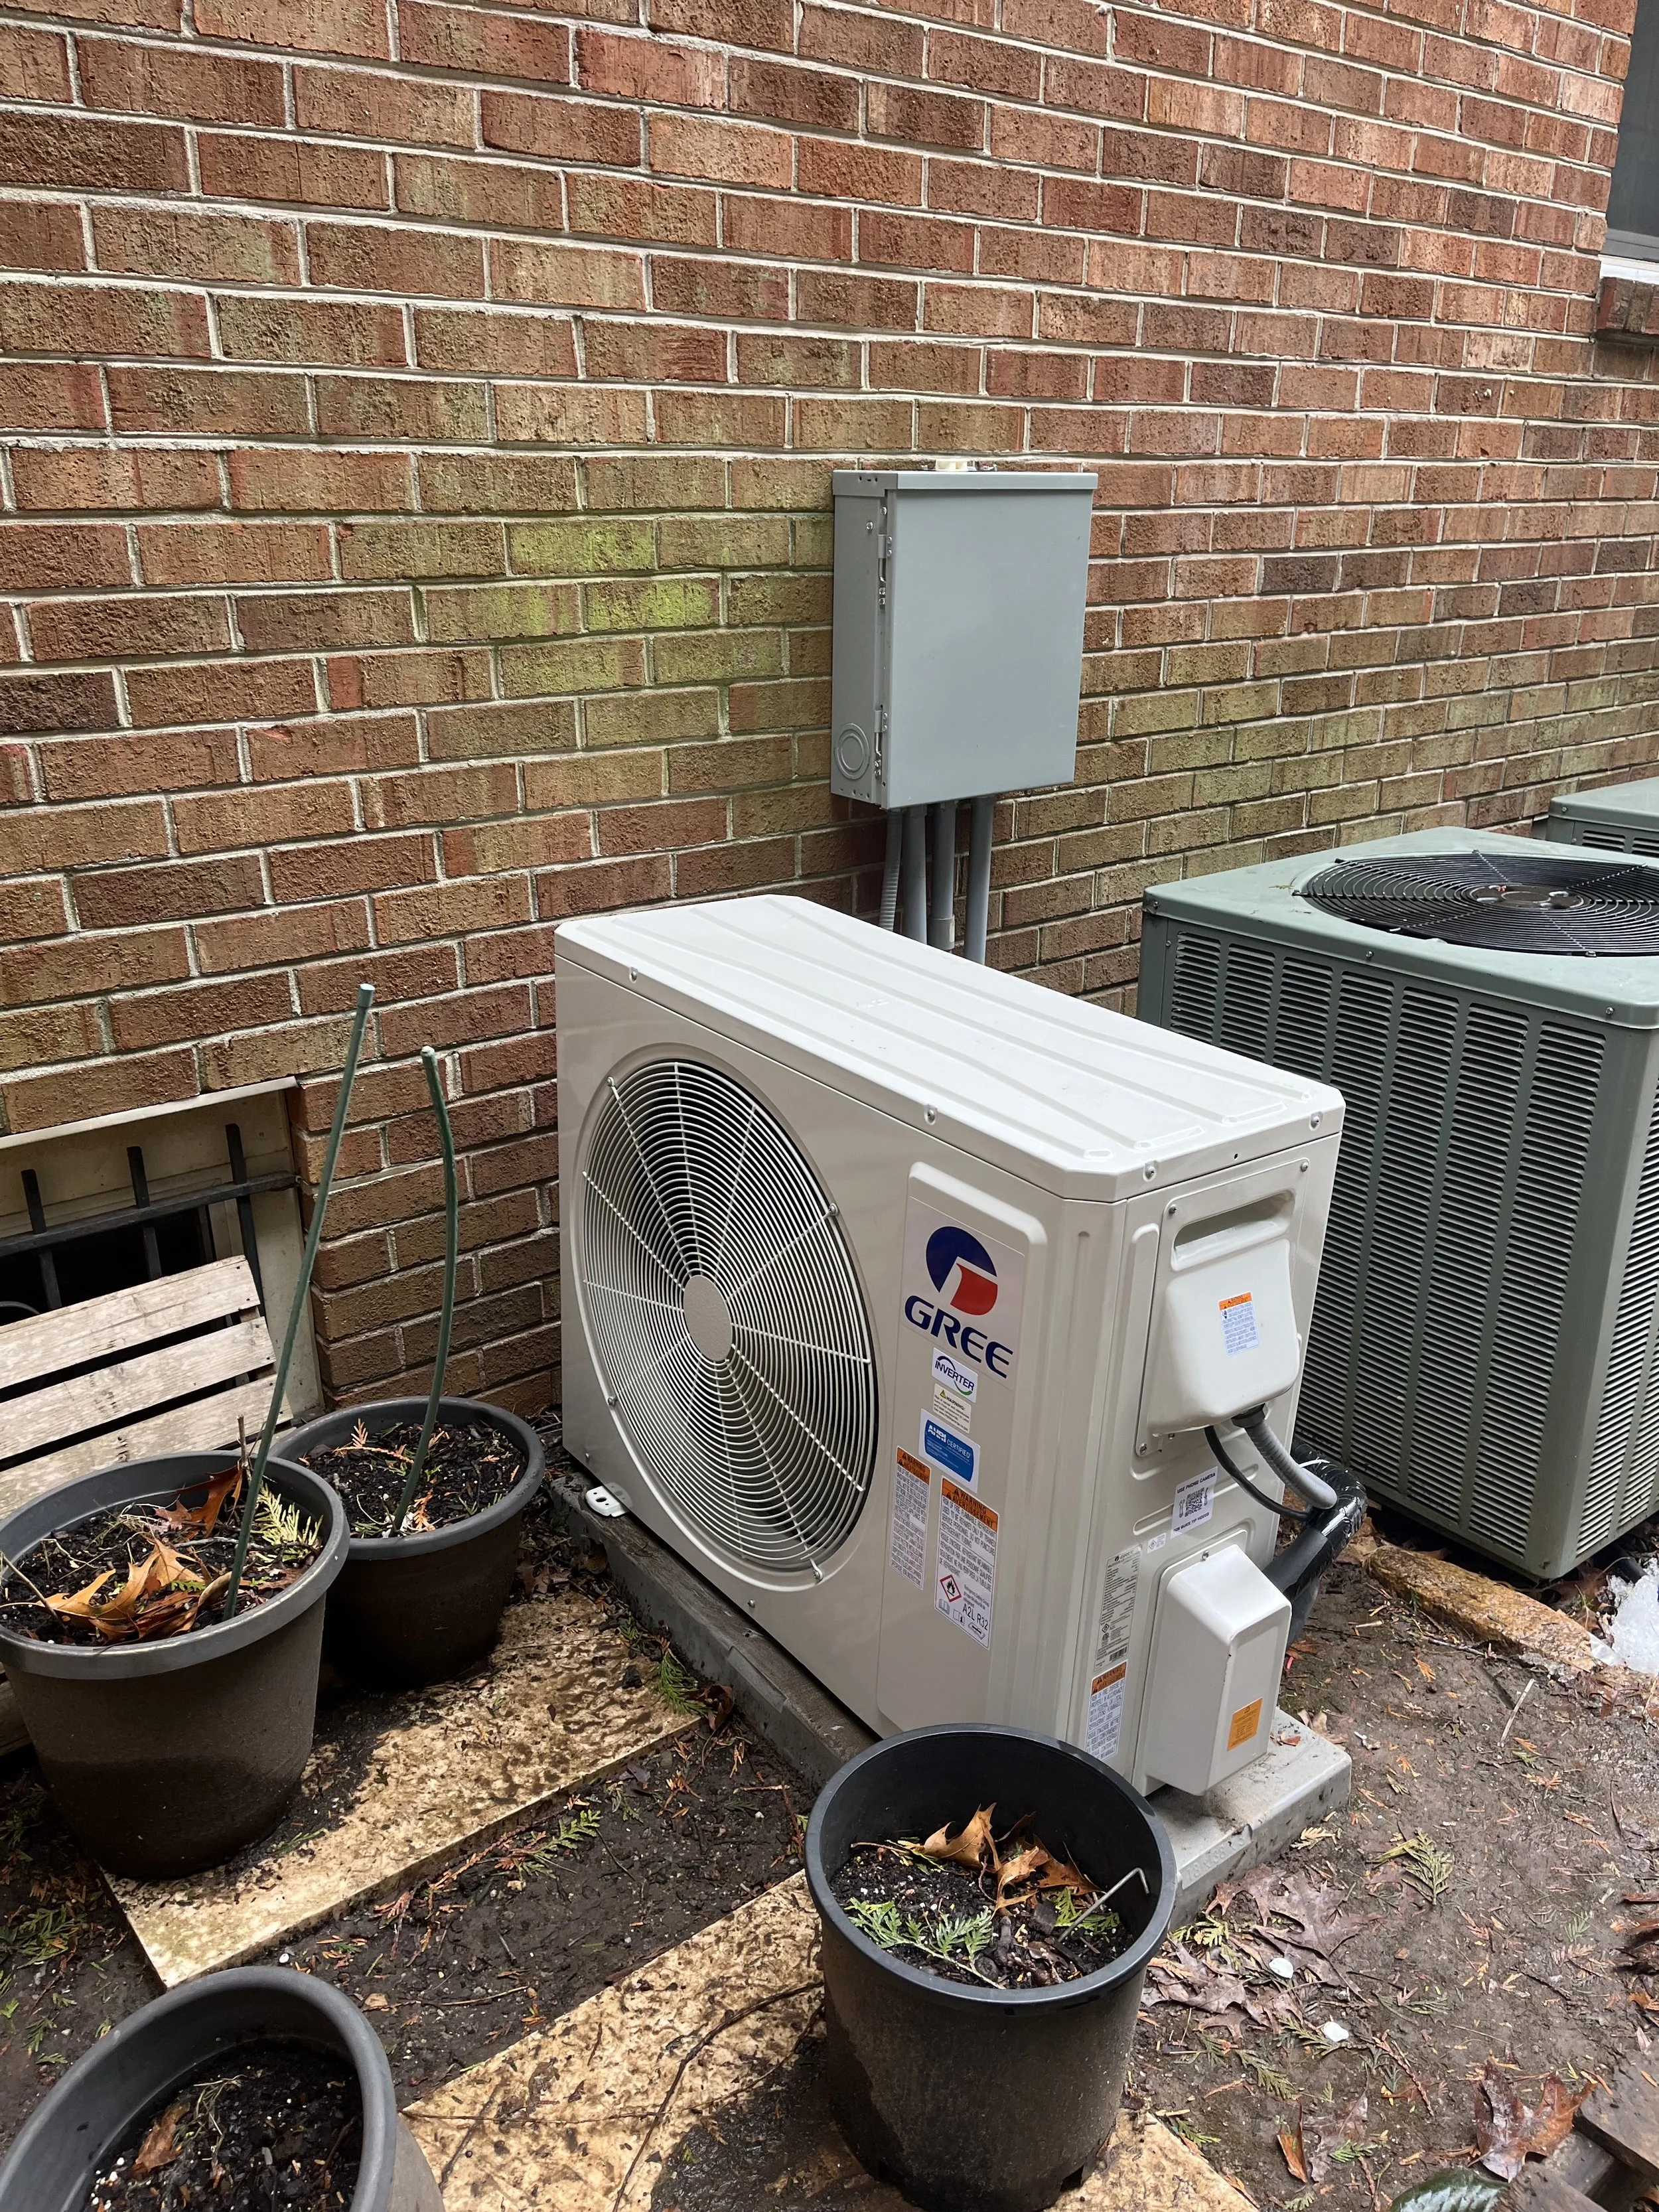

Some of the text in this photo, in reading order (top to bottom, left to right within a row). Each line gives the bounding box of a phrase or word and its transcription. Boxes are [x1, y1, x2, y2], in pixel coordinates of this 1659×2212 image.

[904, 1295, 1014, 1379] GREE
[934, 1360, 975, 1391] INVERTER
[1186, 1480, 1199, 1489] PHONE
[1199, 1473, 1216, 1483] CAMERA
[952, 1495, 993, 1527] AVERTISSEMENT
[961, 1490, 987, 1514] WARNING
[962, 1603, 975, 1621] A2L
[977, 1613, 988, 1631] R32
